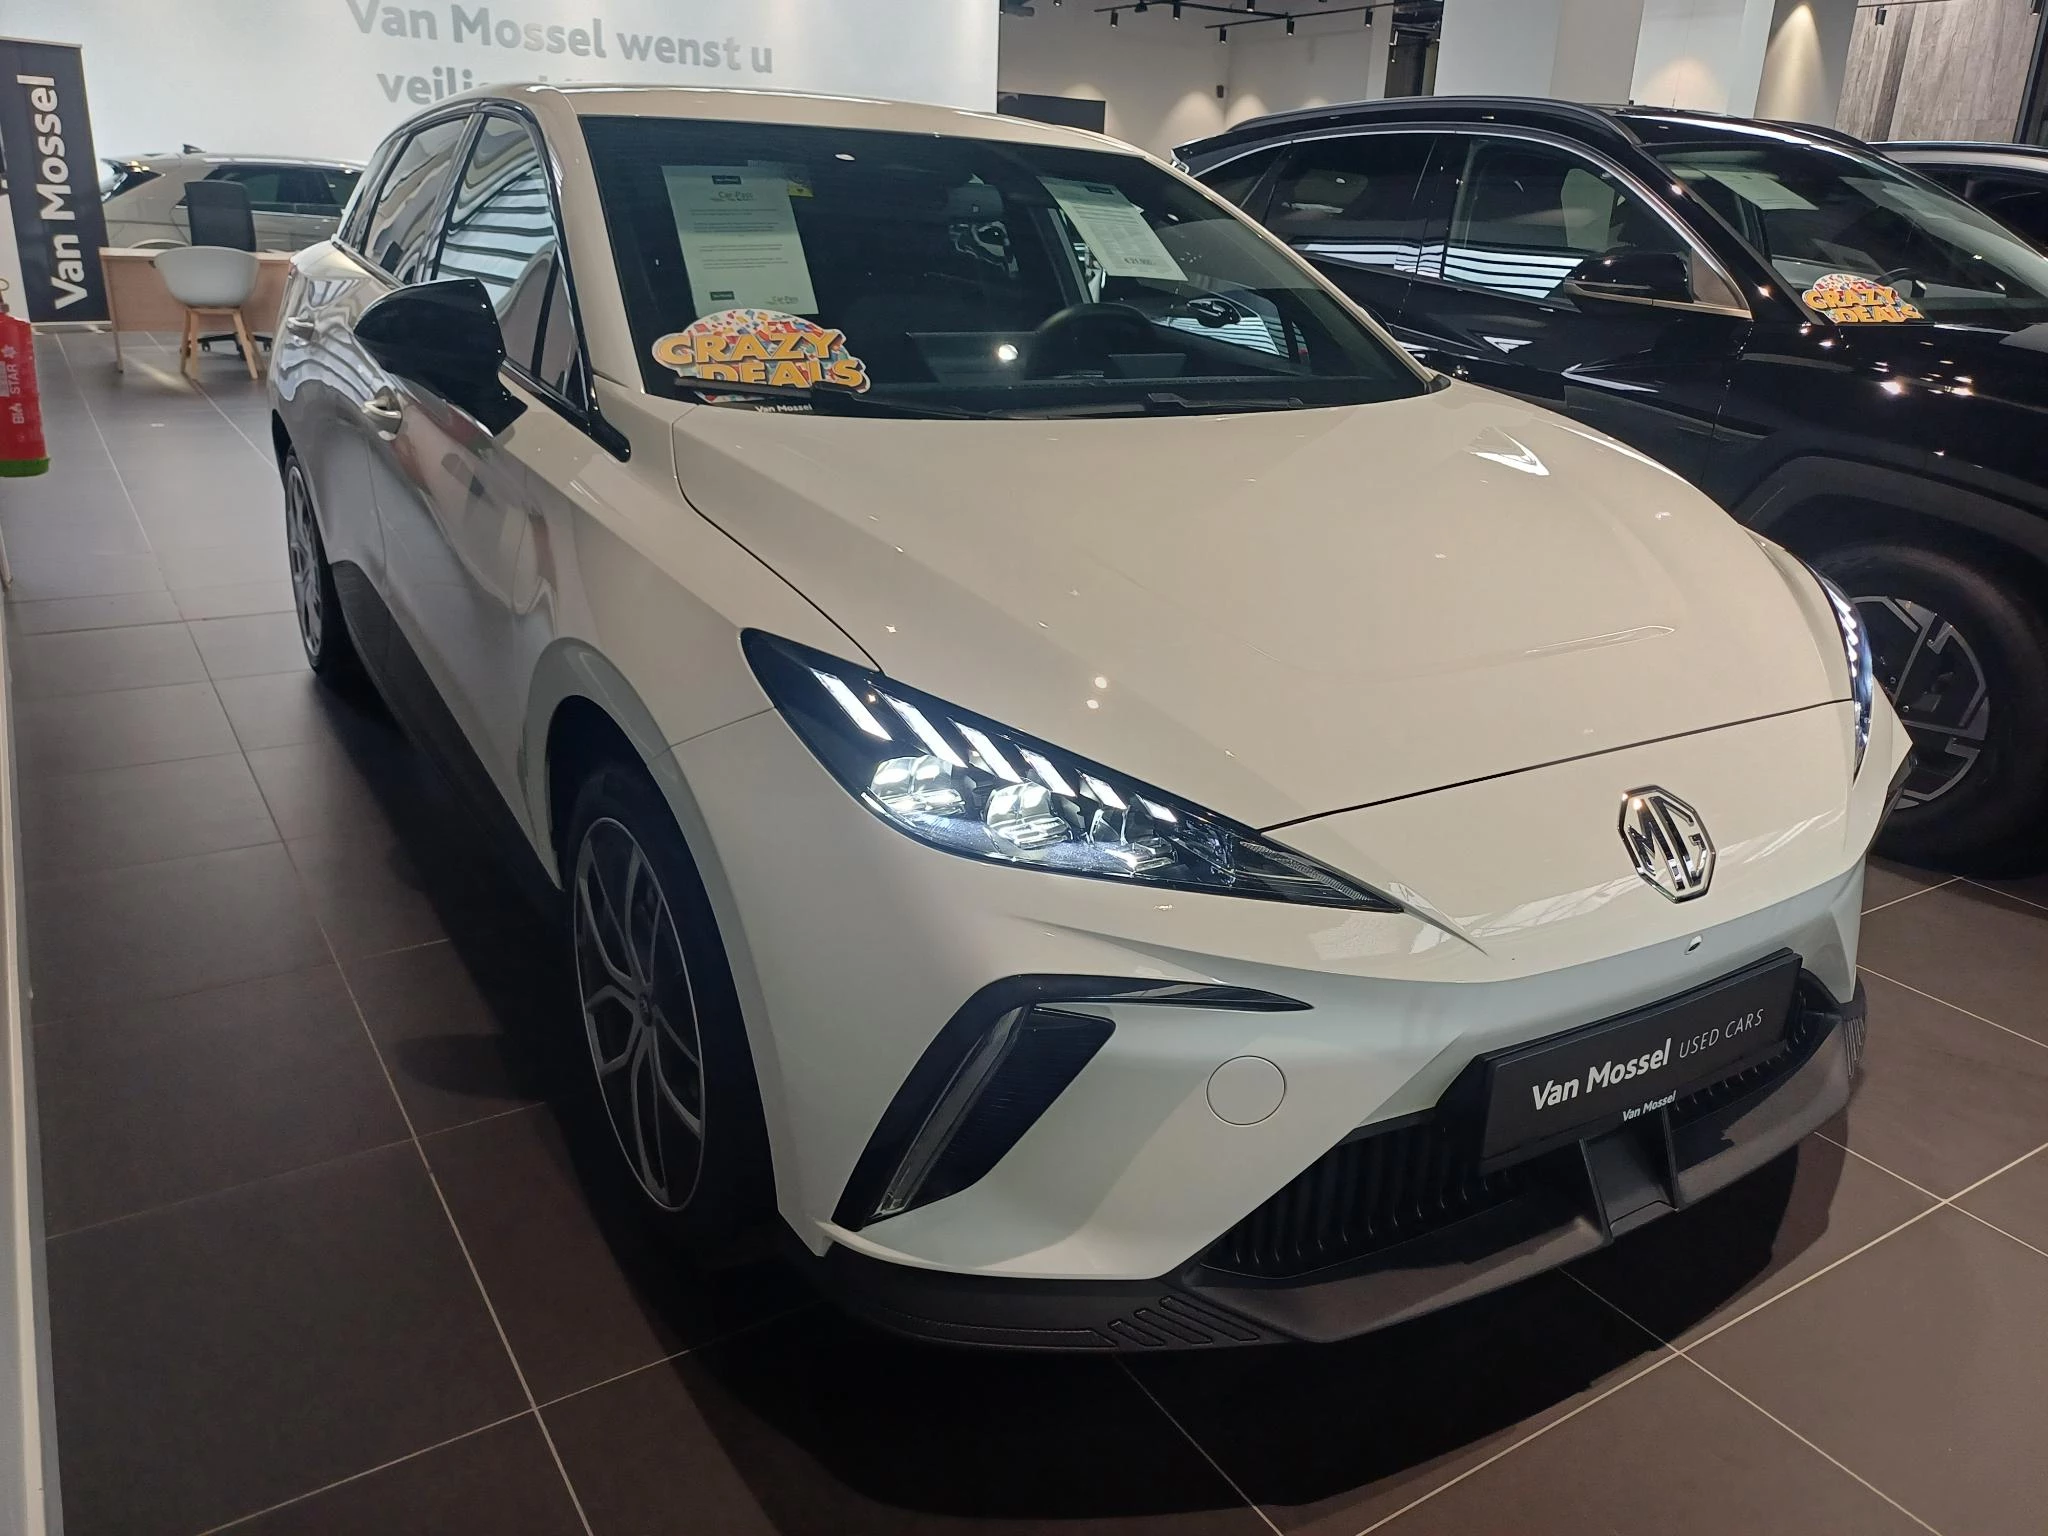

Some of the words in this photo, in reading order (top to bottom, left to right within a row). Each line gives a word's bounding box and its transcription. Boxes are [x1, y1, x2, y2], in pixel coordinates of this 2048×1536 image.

[345, 0, 438, 40] Van
[451, 5, 607, 58] Mossel
[616, 31, 740, 70] wenst
[751, 47, 773, 73] u
[376, 65, 488, 105] veili
[17, 74, 76, 220] Mossel
[51, 234, 88, 310] Van
[1804, 288, 1897, 309] CRAZY
[1837, 304, 1925, 323] DEALS
[659, 333, 843, 365] CRAZY
[6, 364, 20, 394] STAR
[700, 359, 864, 389] DEALS
[754, 405, 776, 413] Van
[776, 403, 813, 412] Mossel
[1627, 795, 1707, 892] MG
[1532, 1077, 1579, 1111] Van
[1586, 1038, 1672, 1093] Mossel
[1679, 1028, 1720, 1059] USED
[1725, 1008, 1764, 1039] CARS
[1622, 1106, 1641, 1122] Van
[1642, 1090, 1677, 1116] Mossel
